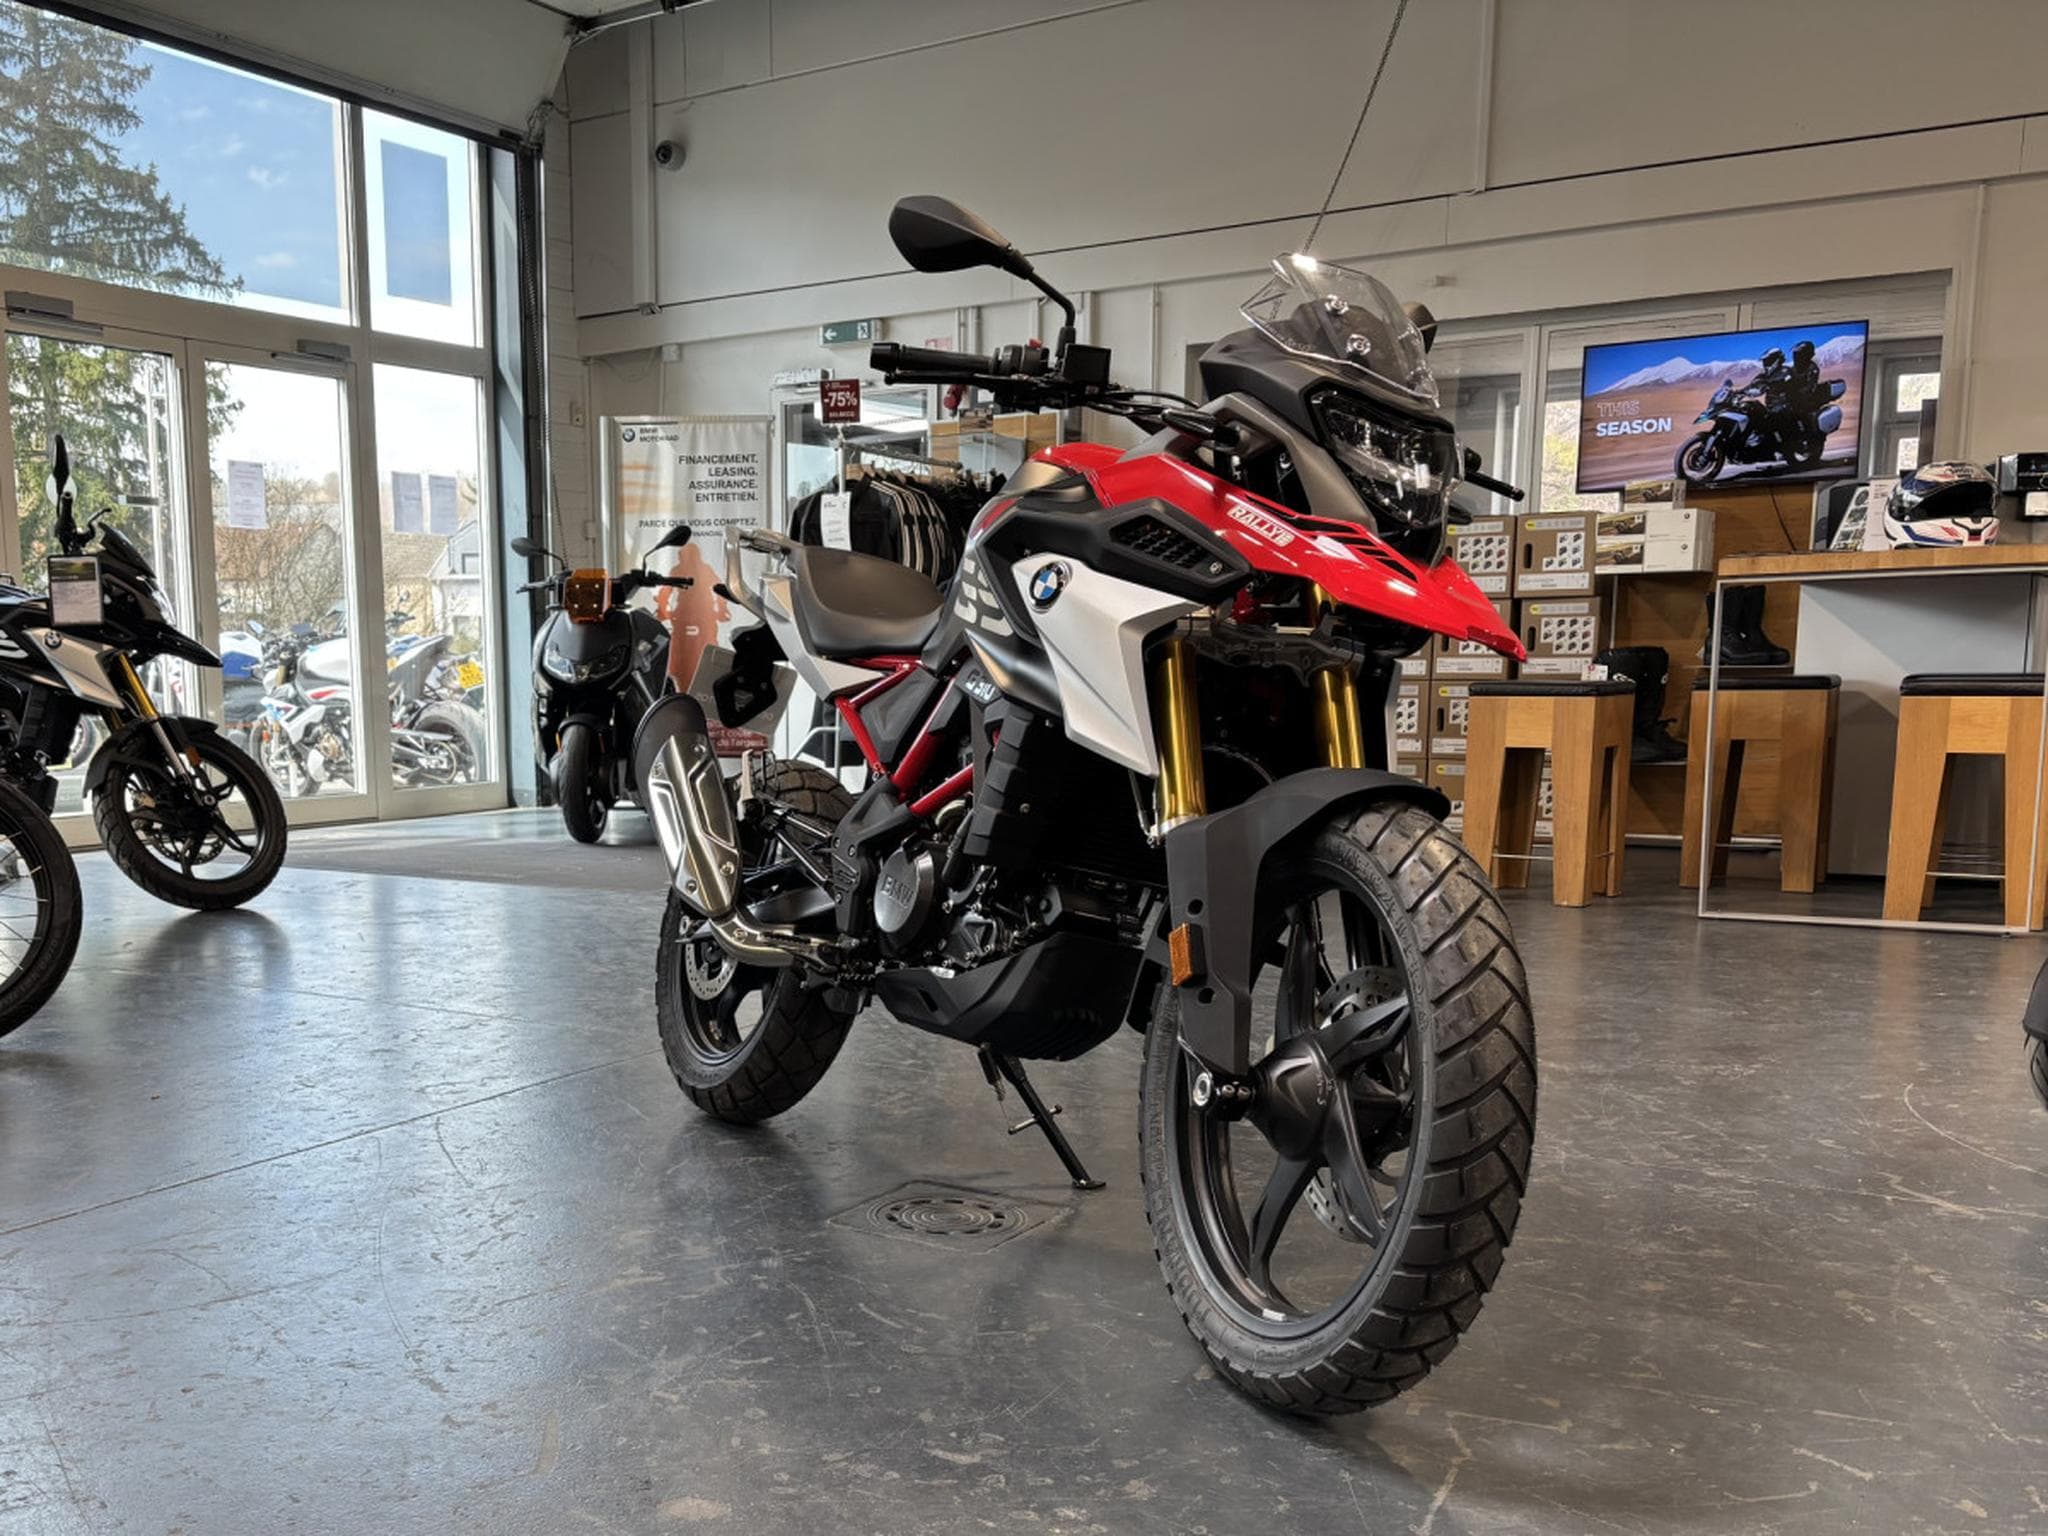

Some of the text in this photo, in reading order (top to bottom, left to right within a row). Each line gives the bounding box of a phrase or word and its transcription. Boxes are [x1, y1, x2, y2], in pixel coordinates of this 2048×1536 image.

[824, 391, 857, 407] -75%
[1597, 400, 1640, 417] THIS
[1596, 418, 1672, 437] SEASON
[678, 453, 758, 464] FINANCEMENT.
[708, 467, 758, 477] LEASING.
[688, 479, 758, 490] ASSURANCE.
[695, 492, 758, 503] ENTRETIEN.
[639, 519, 667, 528] PARCE
[688, 518, 712, 527] VOUS
[713, 518, 758, 527] COMPTEZ.
[880, 873, 915, 909] BMW
